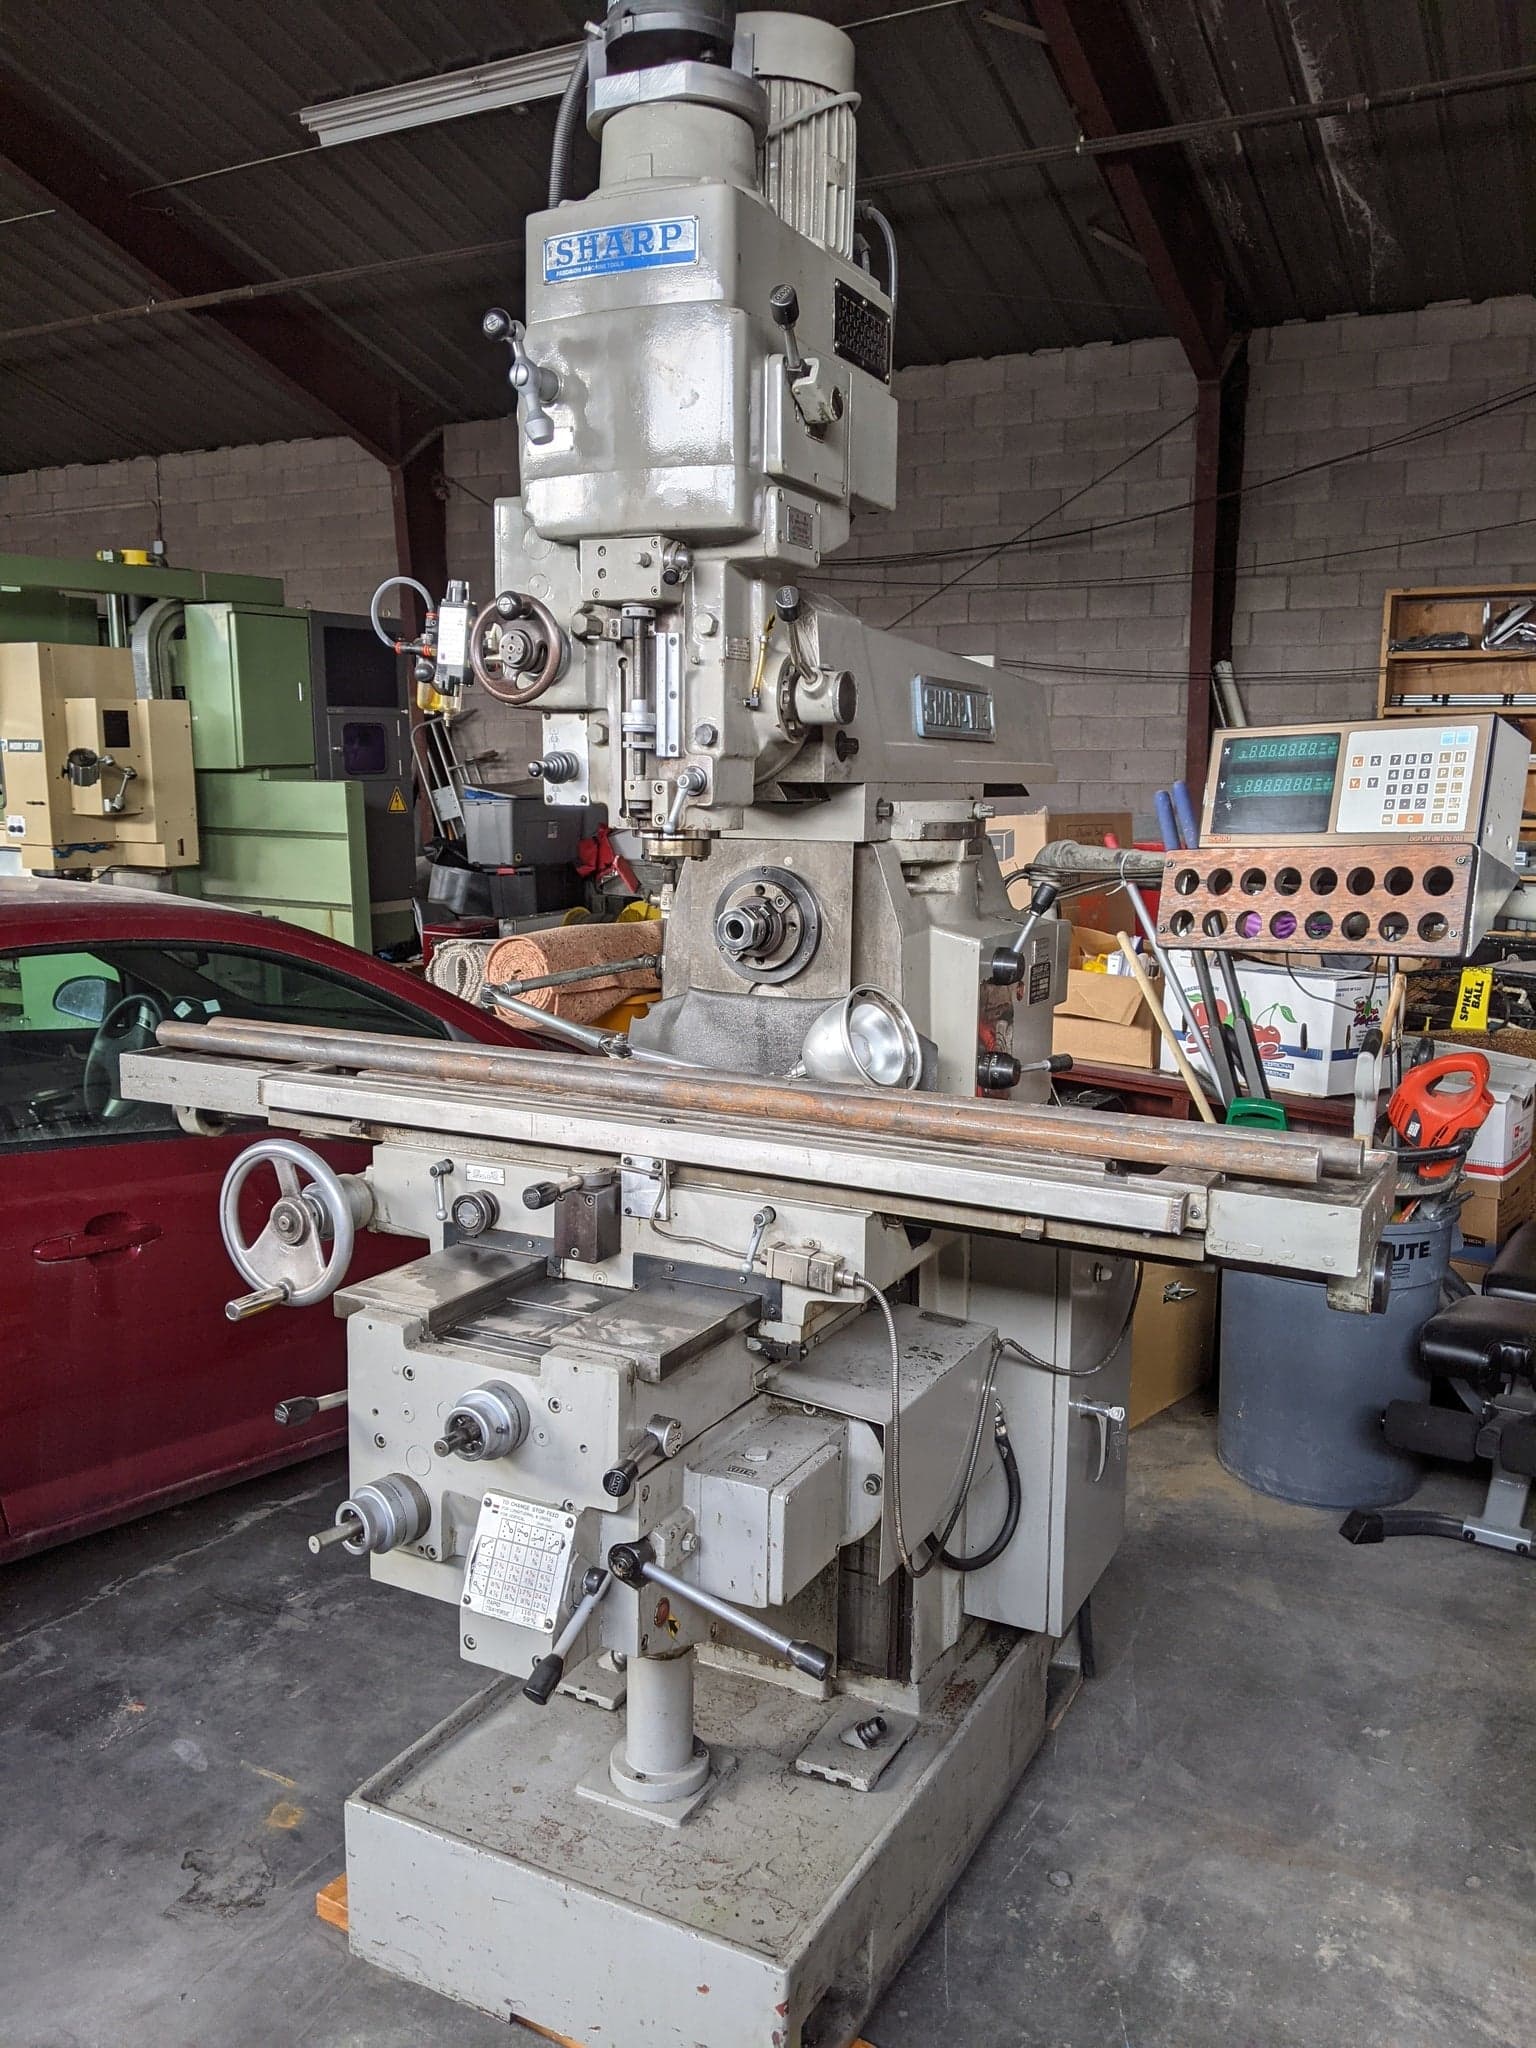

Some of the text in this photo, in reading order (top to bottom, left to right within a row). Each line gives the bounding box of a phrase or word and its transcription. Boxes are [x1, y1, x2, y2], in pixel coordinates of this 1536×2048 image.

[556, 223, 682, 266] SHARP
[1224, 747, 1231, 755] X
[1459, 986, 1473, 1022] SPIKE
[1471, 980, 1485, 1009] BALL
[1392, 1240, 1431, 1262] UTE
